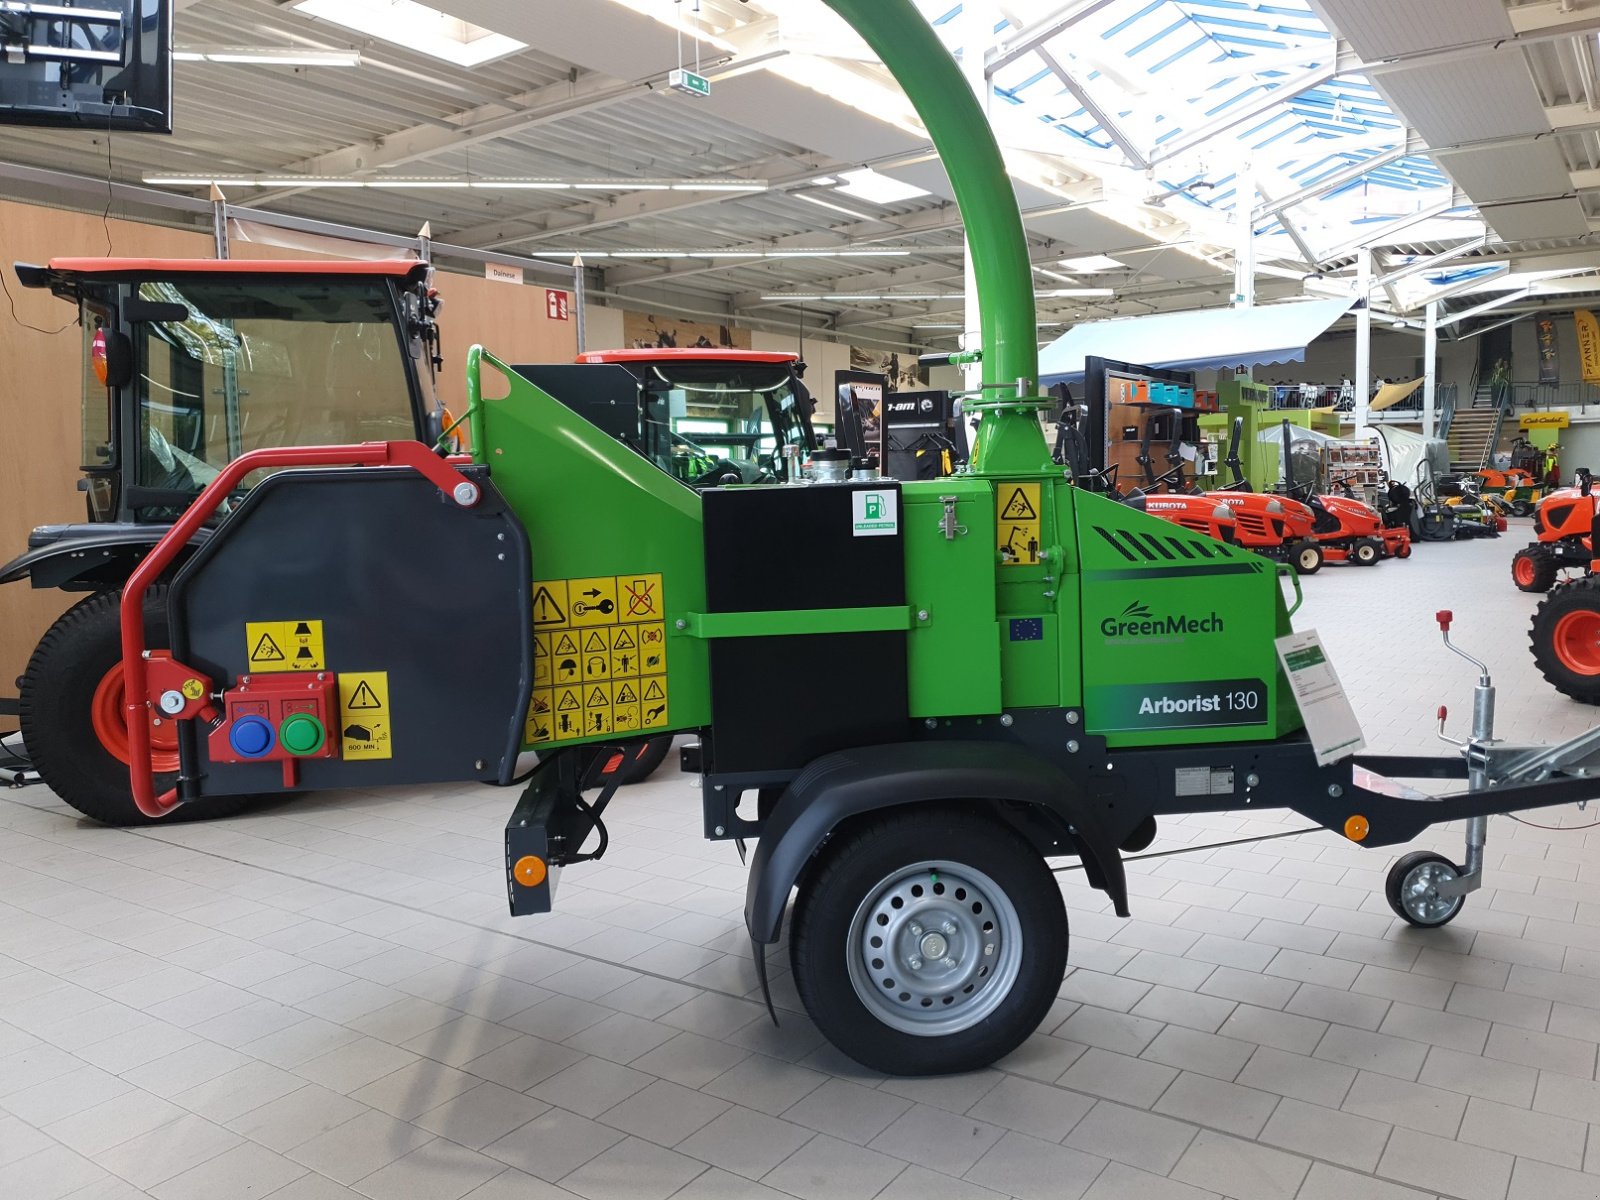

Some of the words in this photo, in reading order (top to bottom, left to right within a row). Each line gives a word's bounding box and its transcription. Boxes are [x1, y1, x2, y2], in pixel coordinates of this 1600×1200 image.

[493, 269, 516, 279] Dainese
[1581, 322, 1593, 375] PFANNER
[869, 505, 877, 515] P
[1100, 611, 1224, 637] GreenMech
[183, 679, 196, 690] STOP
[1138, 694, 1220, 715] Arborist
[1225, 691, 1258, 711] 130
